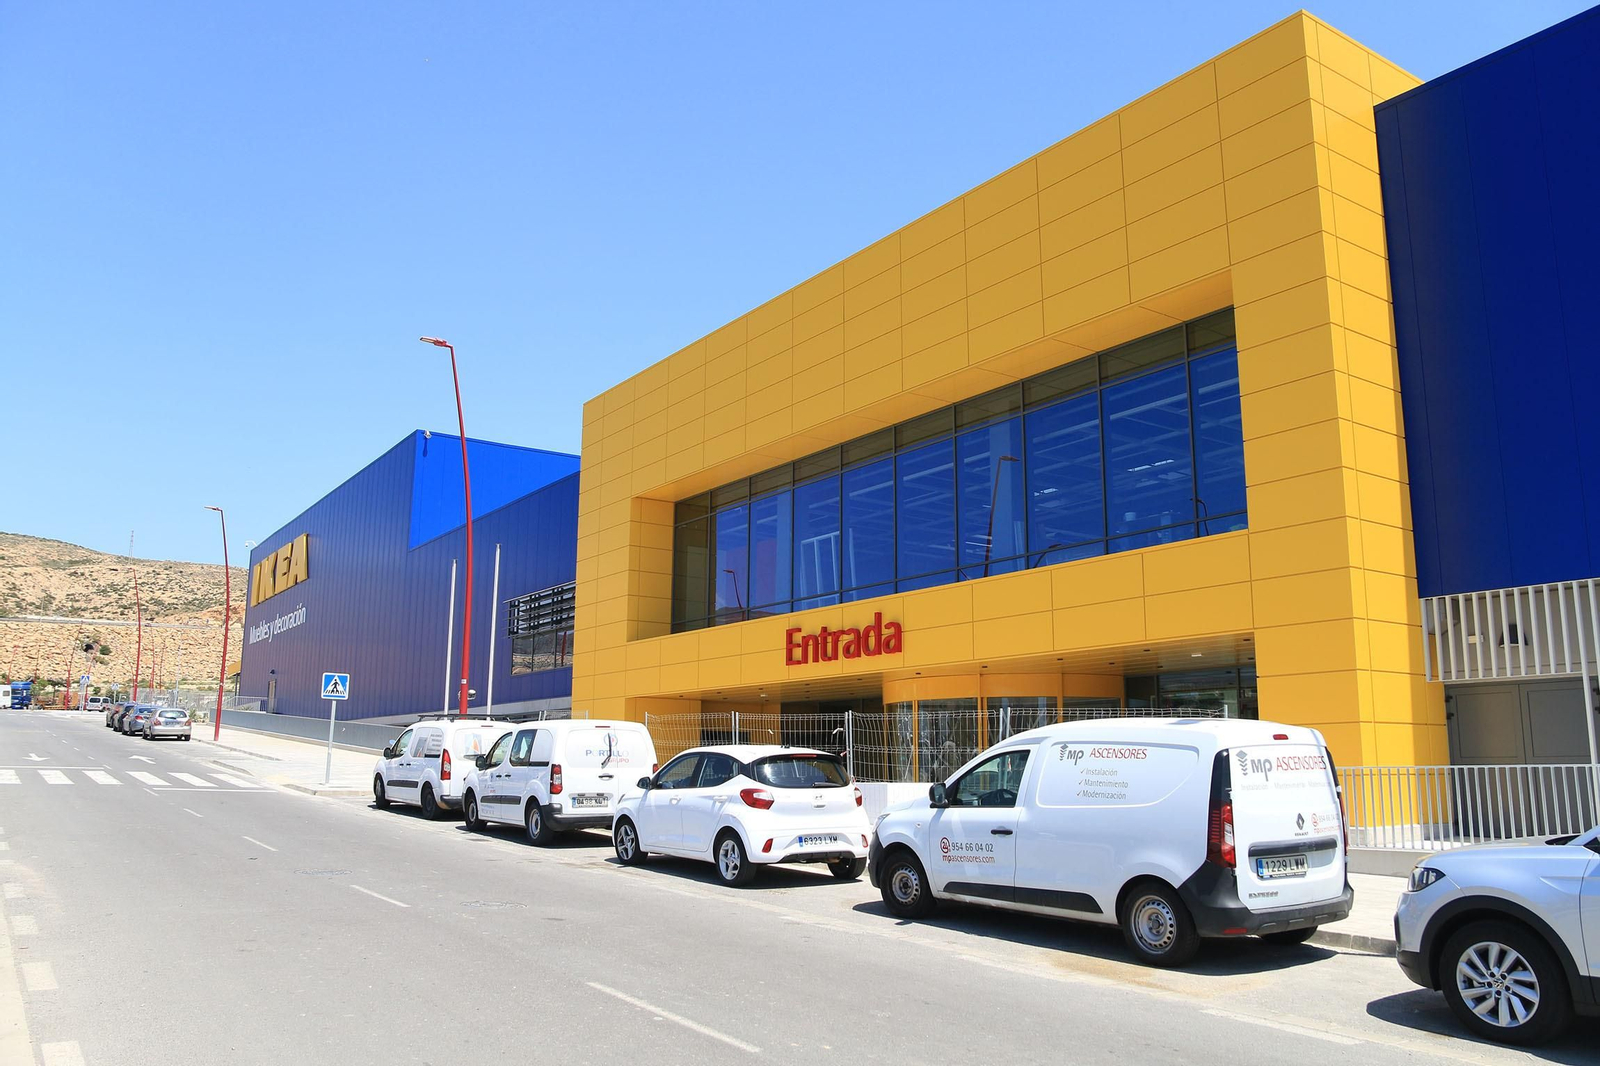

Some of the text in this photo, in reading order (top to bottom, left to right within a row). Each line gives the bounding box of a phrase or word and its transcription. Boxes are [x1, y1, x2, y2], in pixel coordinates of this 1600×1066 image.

[250, 532, 309, 608] IKEA
[249, 620, 269, 645] Muebles
[273, 603, 307, 635] decoración
[785, 611, 903, 666] Entrada
[1089, 747, 1148, 760] ASCENSORES
[1276, 755, 1327, 771] ASCENSORES
[1085, 768, 1118, 777] Instalación
[1083, 779, 1129, 789] Mantenimiento
[1082, 790, 1127, 800] Modernización
[804, 836, 823, 846] 6323
[951, 841, 964, 851] 954
[965, 842, 974, 852] 66
[975, 842, 984, 852] 04
[985, 843, 994, 853] 02
[942, 854, 996, 864] mpascensores.com
[1265, 859, 1288, 873] 1229
